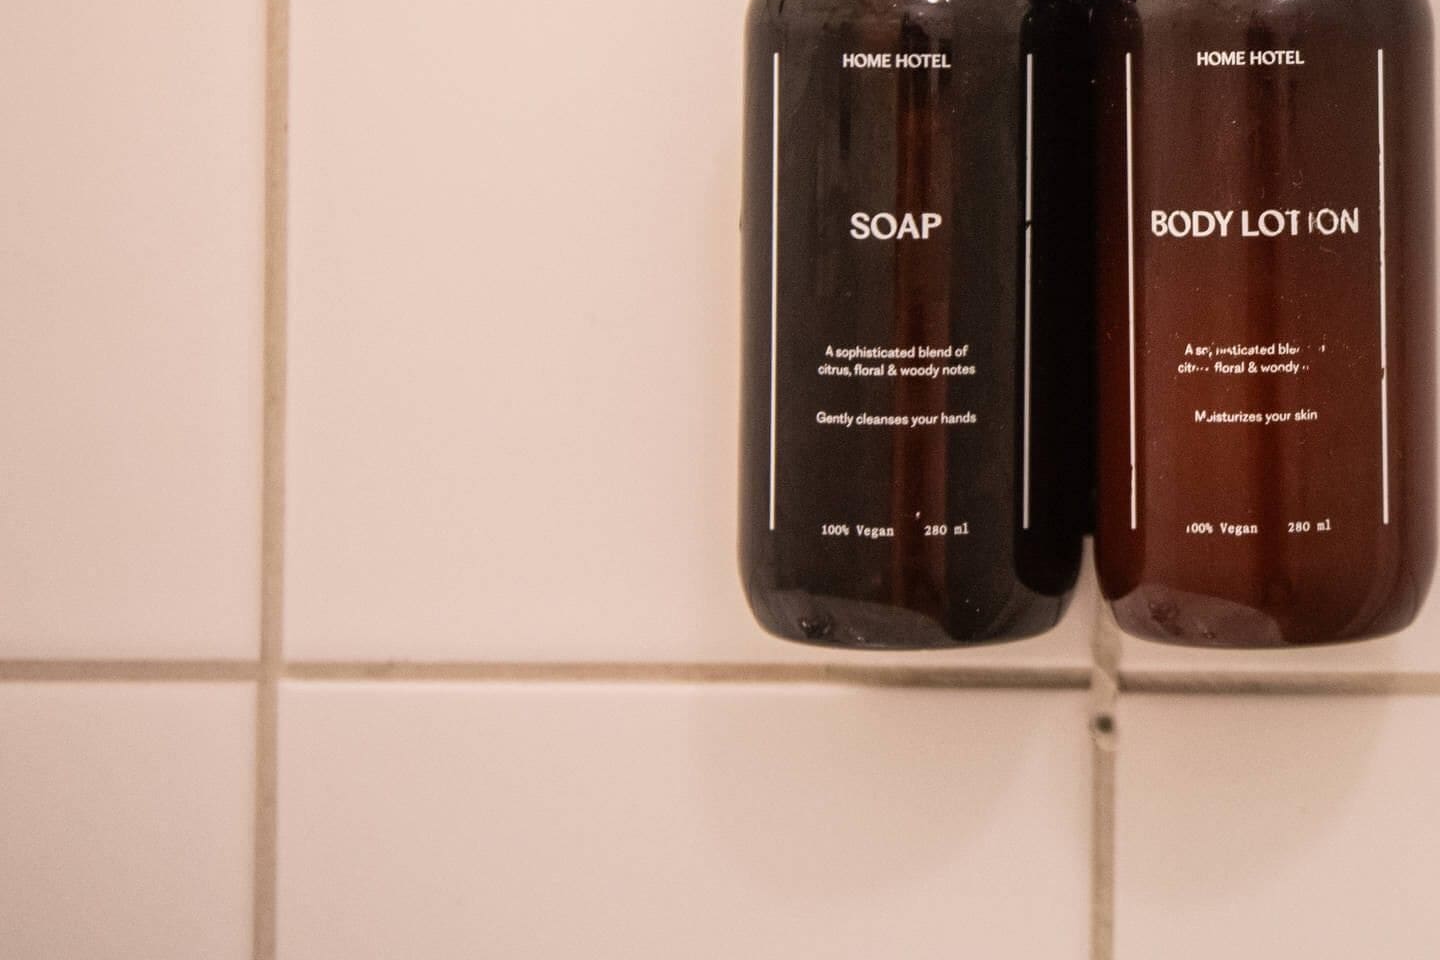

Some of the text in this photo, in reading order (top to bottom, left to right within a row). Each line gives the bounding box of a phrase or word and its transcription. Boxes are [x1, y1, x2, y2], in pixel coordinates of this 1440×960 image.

[842, 53, 952, 68] HOME HOTEL
[1197, 50, 1305, 66] HOME HOTEL
[849, 212, 942, 240] SOAP
[1151, 207, 1360, 238] BODY LOTION
[825, 344, 969, 361] A sophisticated blend of
[1184, 343, 1195, 356] A
[817, 364, 976, 379] citrus, floral & woody notes
[1213, 361, 1245, 374] floral
[1247, 361, 1258, 374] &
[816, 411, 977, 428] Gently cleanses your hands
[1264, 412, 1292, 426] your
[1294, 408, 1318, 422] skin
[821, 524, 895, 539] 100% Vegan
[923, 522, 969, 537] 280 ml
[1219, 522, 1258, 538] Vegan
[1287, 518, 1332, 534] 280 ml
